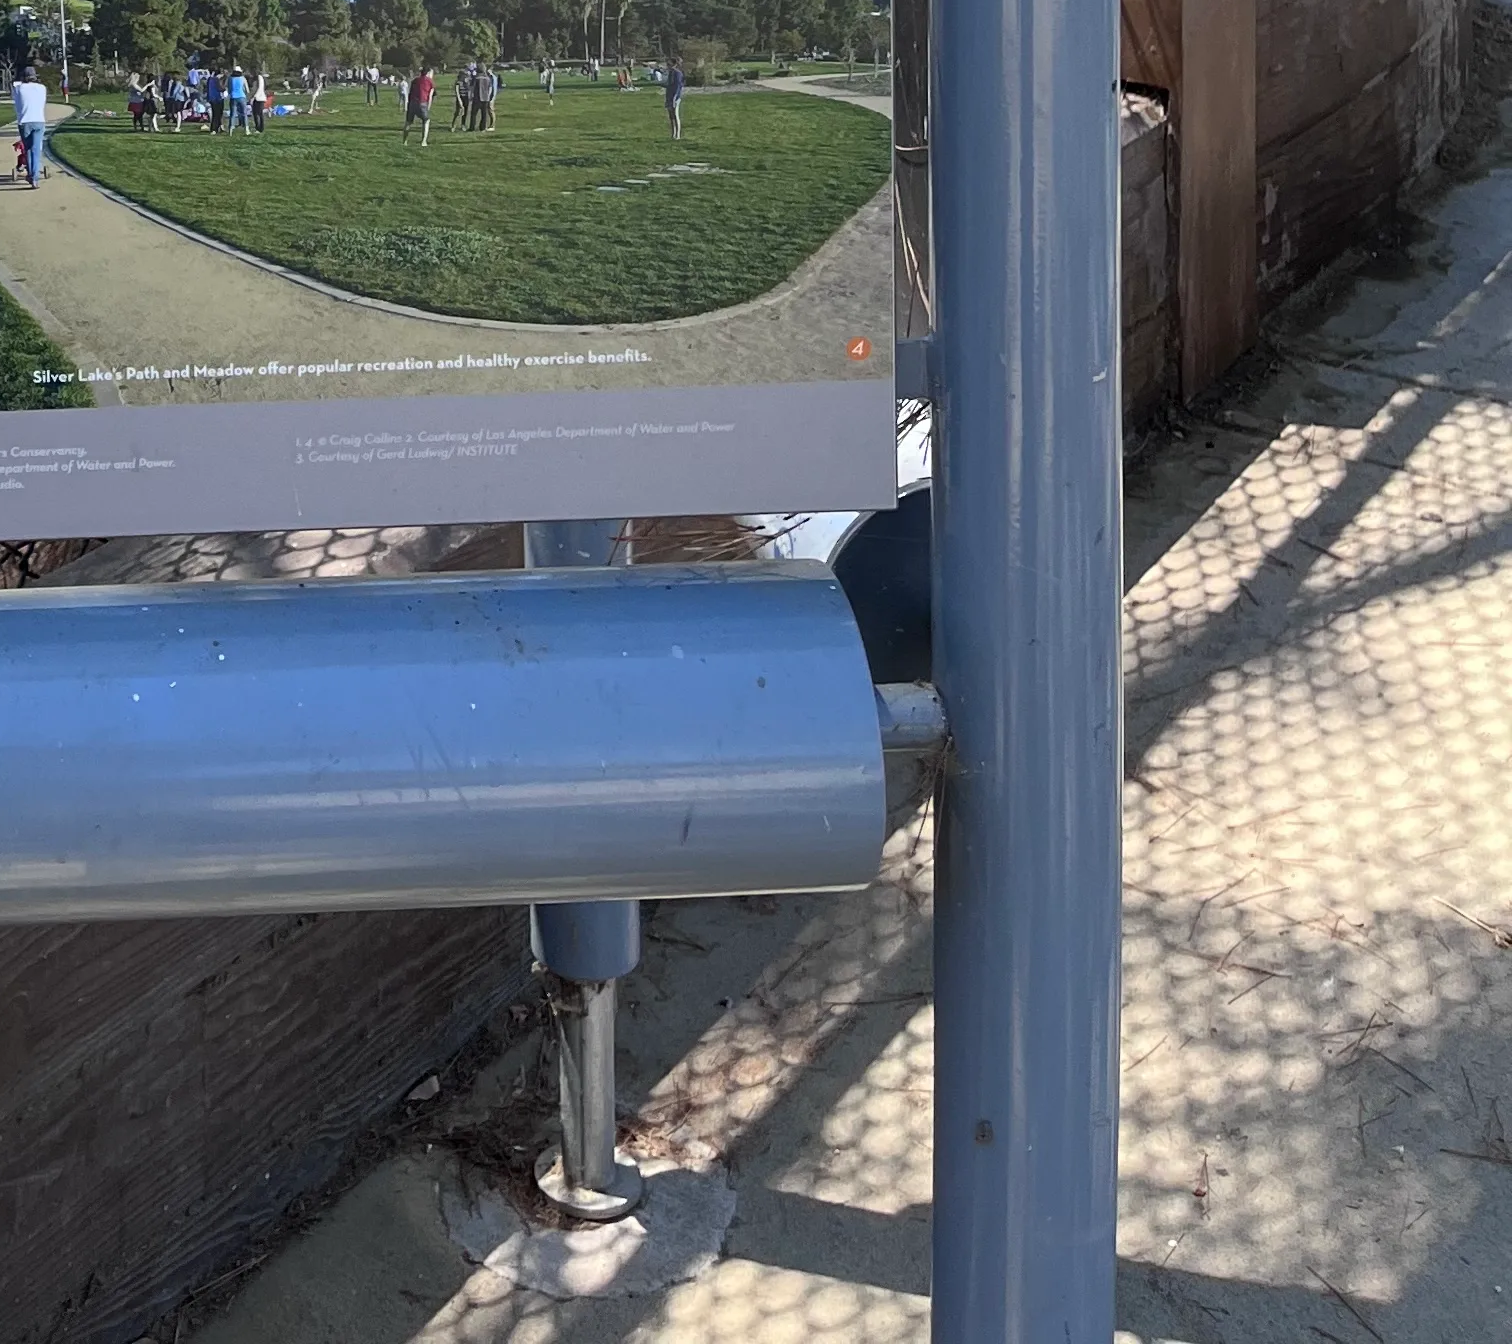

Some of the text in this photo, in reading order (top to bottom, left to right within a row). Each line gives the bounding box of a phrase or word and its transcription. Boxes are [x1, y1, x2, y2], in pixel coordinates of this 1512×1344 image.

[852, 340, 865, 356] 4
[32, 369, 75, 384] Silver
[126, 366, 160, 381] Path
[162, 364, 191, 379] and
[193, 363, 255, 378] Meadow
[258, 360, 295, 376] offer
[297, 358, 353, 377] popular
[356, 356, 433, 372] recreation
[436, 354, 464, 370] and
[466, 352, 521, 370] healthy
[523, 352, 585, 367] exercise
[587, 348, 653, 364] benefits.
